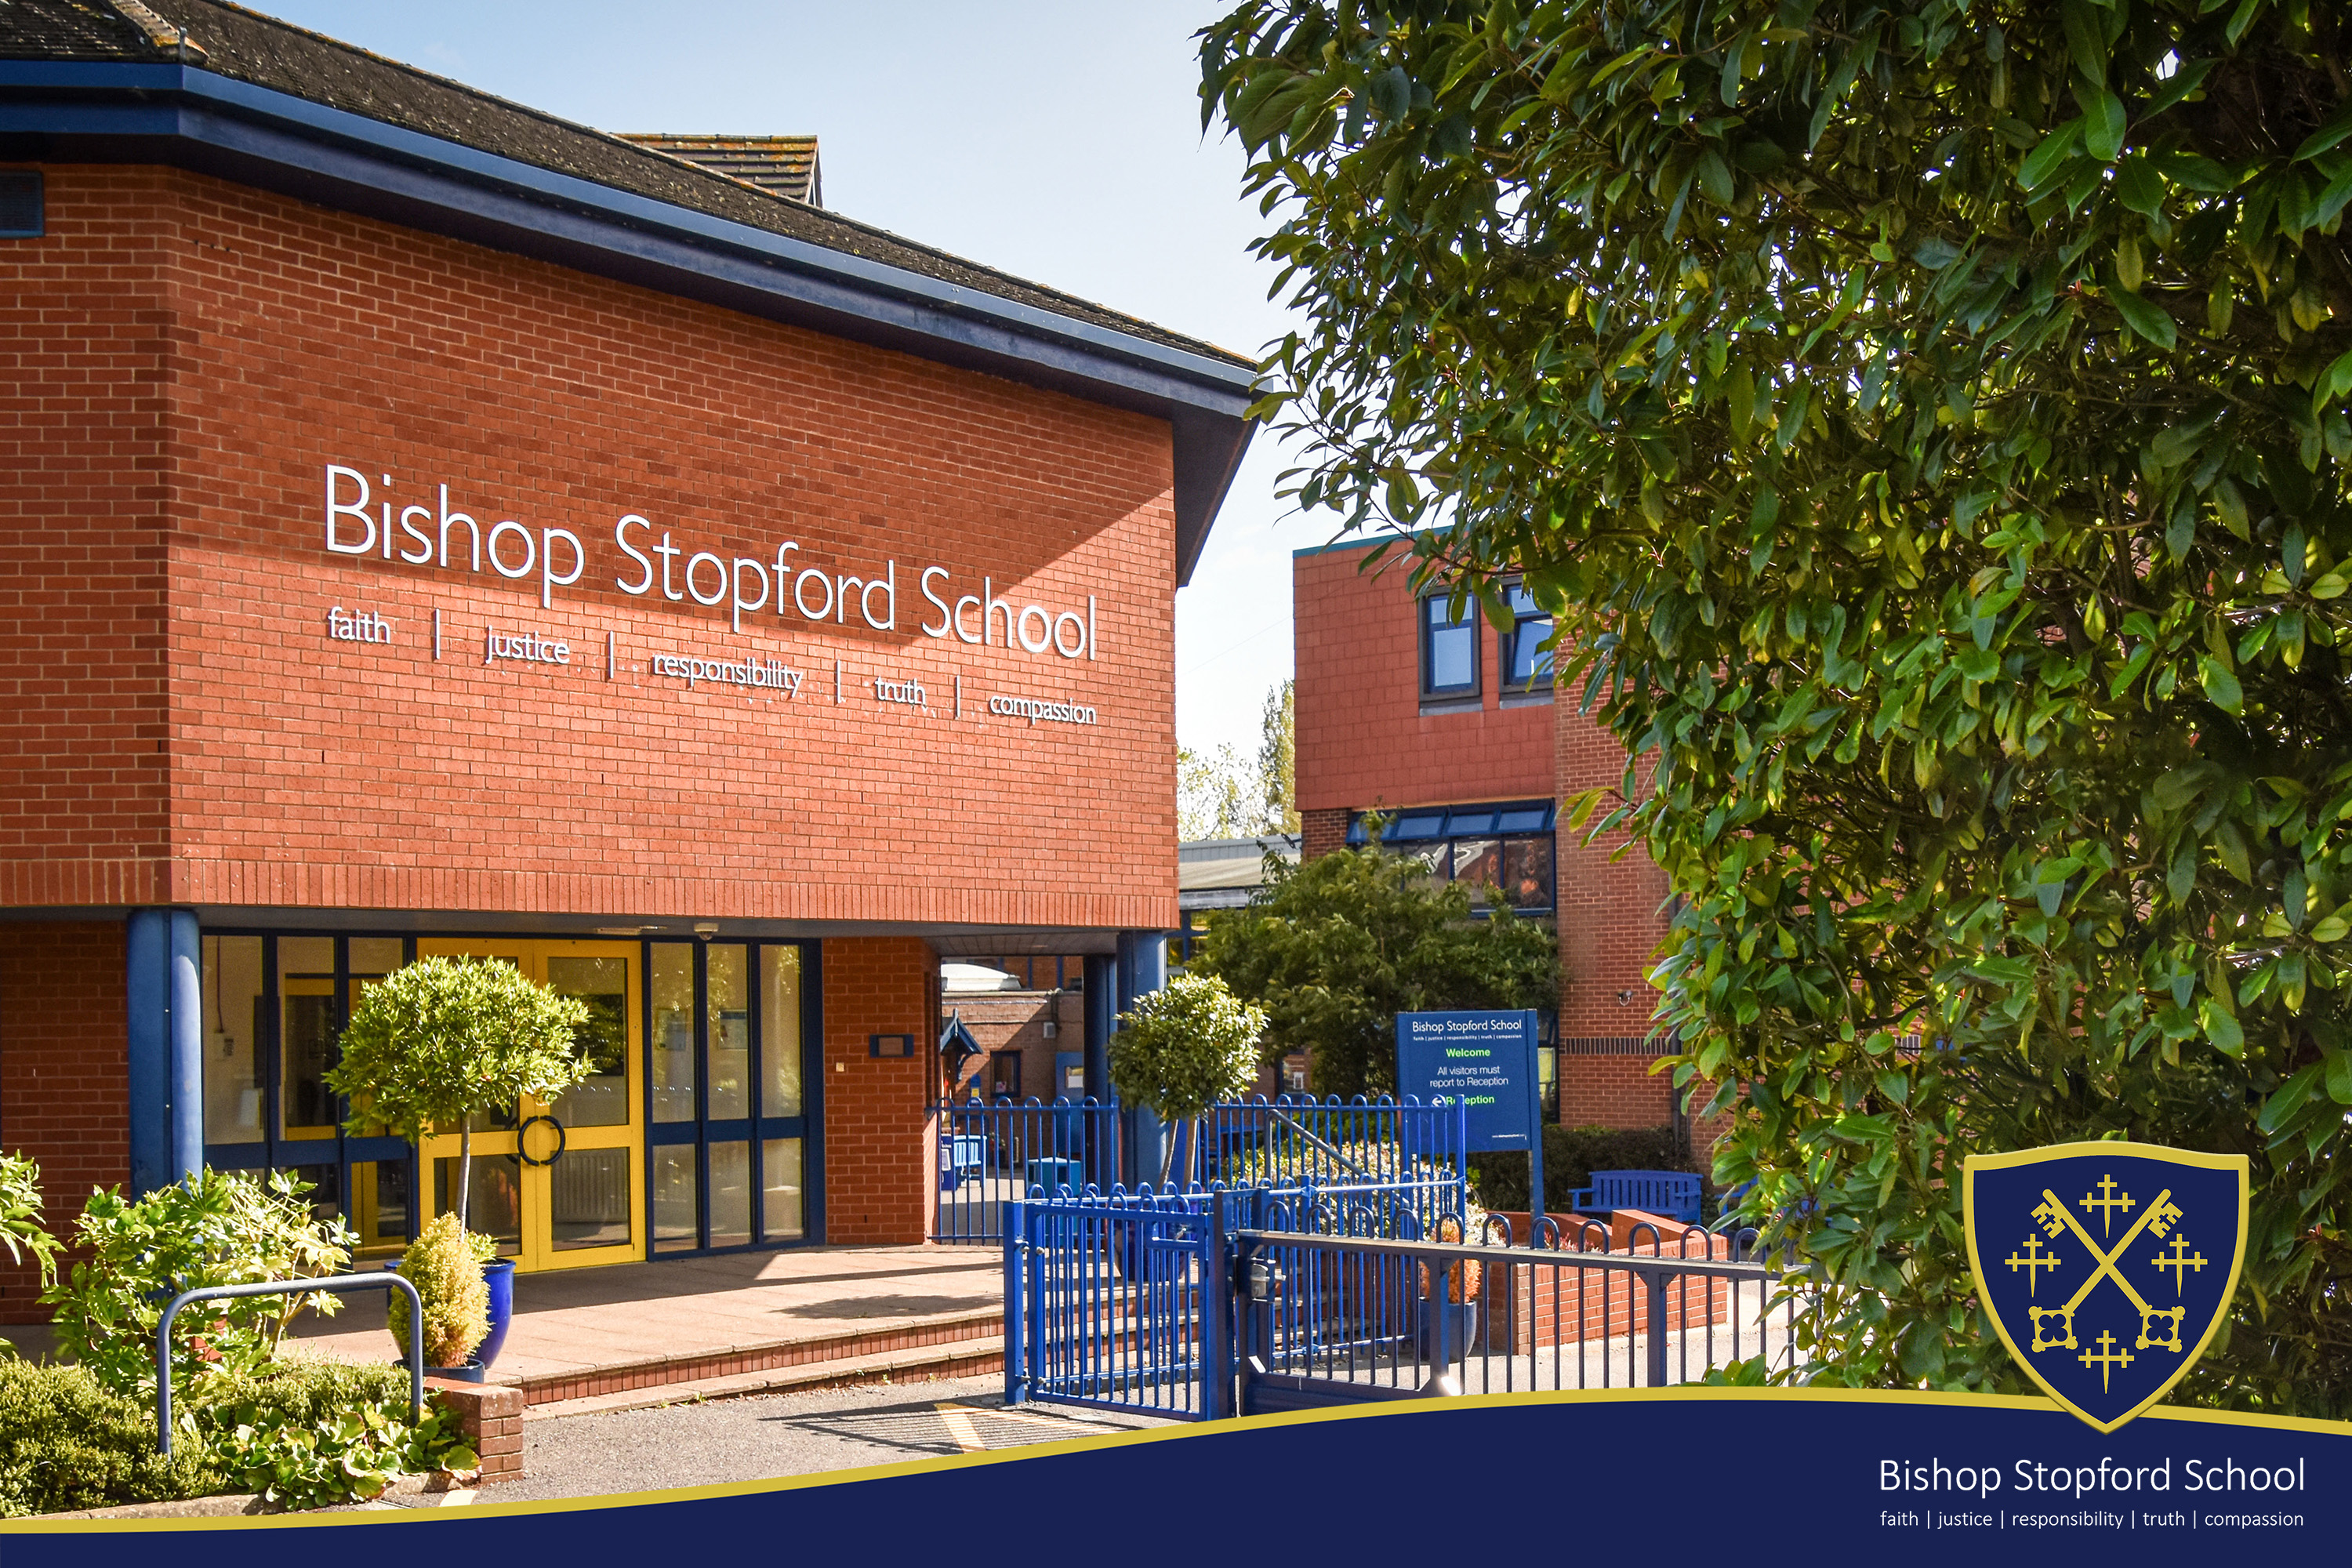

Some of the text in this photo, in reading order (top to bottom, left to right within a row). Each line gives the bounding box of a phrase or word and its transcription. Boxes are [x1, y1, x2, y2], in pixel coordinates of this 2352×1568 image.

[327, 463, 1095, 661] Bishop Stopford School
[328, 606, 1097, 726] faith justice responsibility truth compassion
[1413, 1019, 1522, 1034] Bishop Stopford School
[1446, 1048, 1491, 1058] Welcome
[1437, 1065, 1501, 1076] All visitors must
[1429, 1076, 1509, 1089] report to Reception
[1446, 1095, 1495, 1106] Reption
